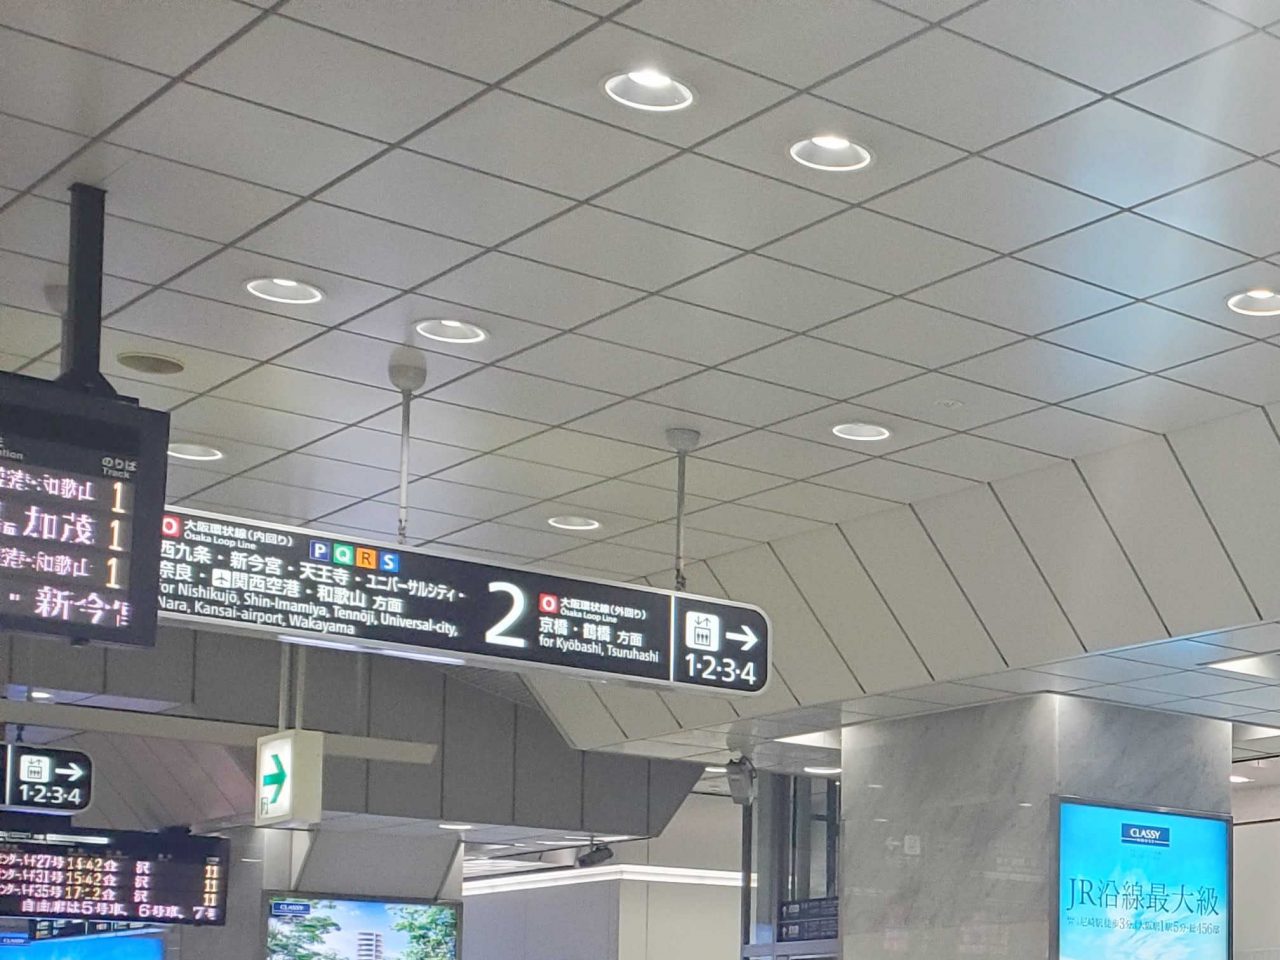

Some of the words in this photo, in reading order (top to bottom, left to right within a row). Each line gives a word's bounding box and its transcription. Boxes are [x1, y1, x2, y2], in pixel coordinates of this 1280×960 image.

[101, 456, 137, 472] のりば
[102, 467, 131, 479] Track
[111, 481, 126, 514] 1
[22, 505, 97, 545] 加茂
[108, 519, 124, 552] 1
[213, 535, 237, 549] Loop
[237, 540, 258, 550] Line
[105, 557, 120, 590] 1
[159, 582, 175, 594] or
[372, 595, 403, 613] 方面
[195, 600, 286, 626] Kansai-airport,
[289, 613, 355, 635] Wakayama
[484, 581, 526, 648] 2
[583, 611, 601, 622] Loop
[602, 614, 618, 624] Line
[617, 630, 643, 648] 方面
[539, 634, 555, 647] for
[607, 644, 659, 663] Tsuruhashi
[1130, 828, 1161, 839] CLASSY
[205, 865, 219, 878] 11
[204, 880, 217, 892] 11
[203, 893, 217, 906] 11
[1066, 877, 1220, 917] JR沿線最大級
